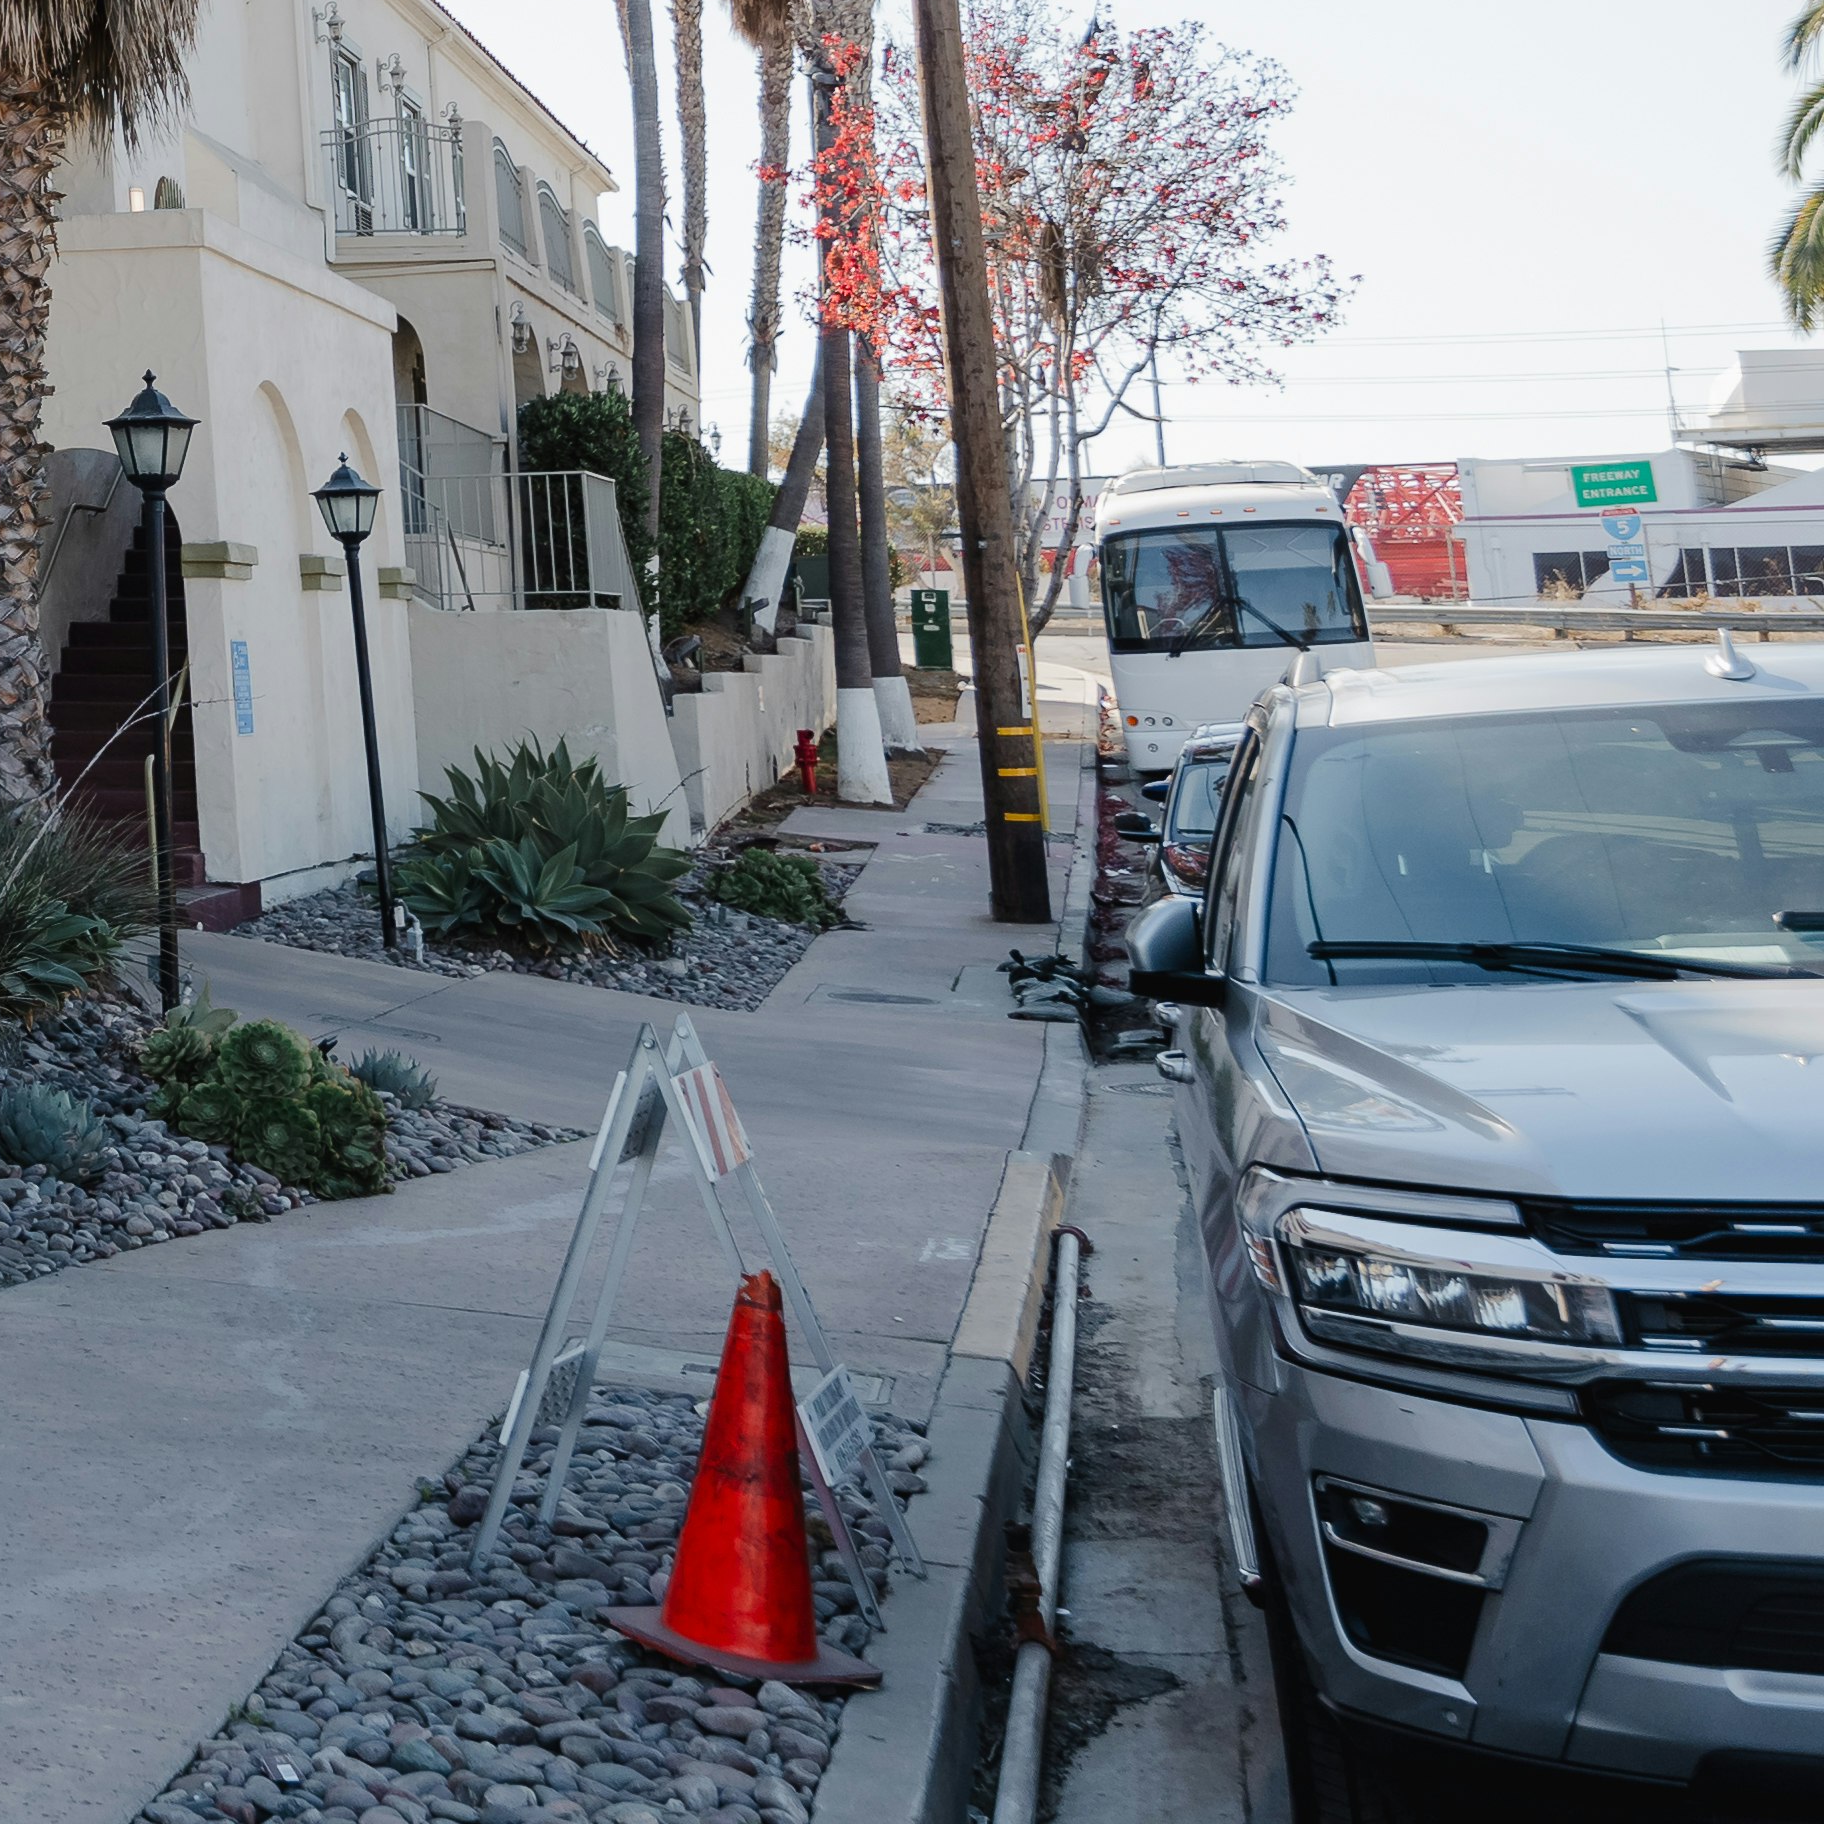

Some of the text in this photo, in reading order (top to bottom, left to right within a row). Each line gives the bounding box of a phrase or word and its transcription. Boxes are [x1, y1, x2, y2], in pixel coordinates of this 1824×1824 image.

[1583, 469, 1639, 482] FREEWAY
[1583, 486, 1648, 499] ENTRANCE
[1617, 520, 1630, 535] 5
[1609, 545, 1643, 556] NORTH
